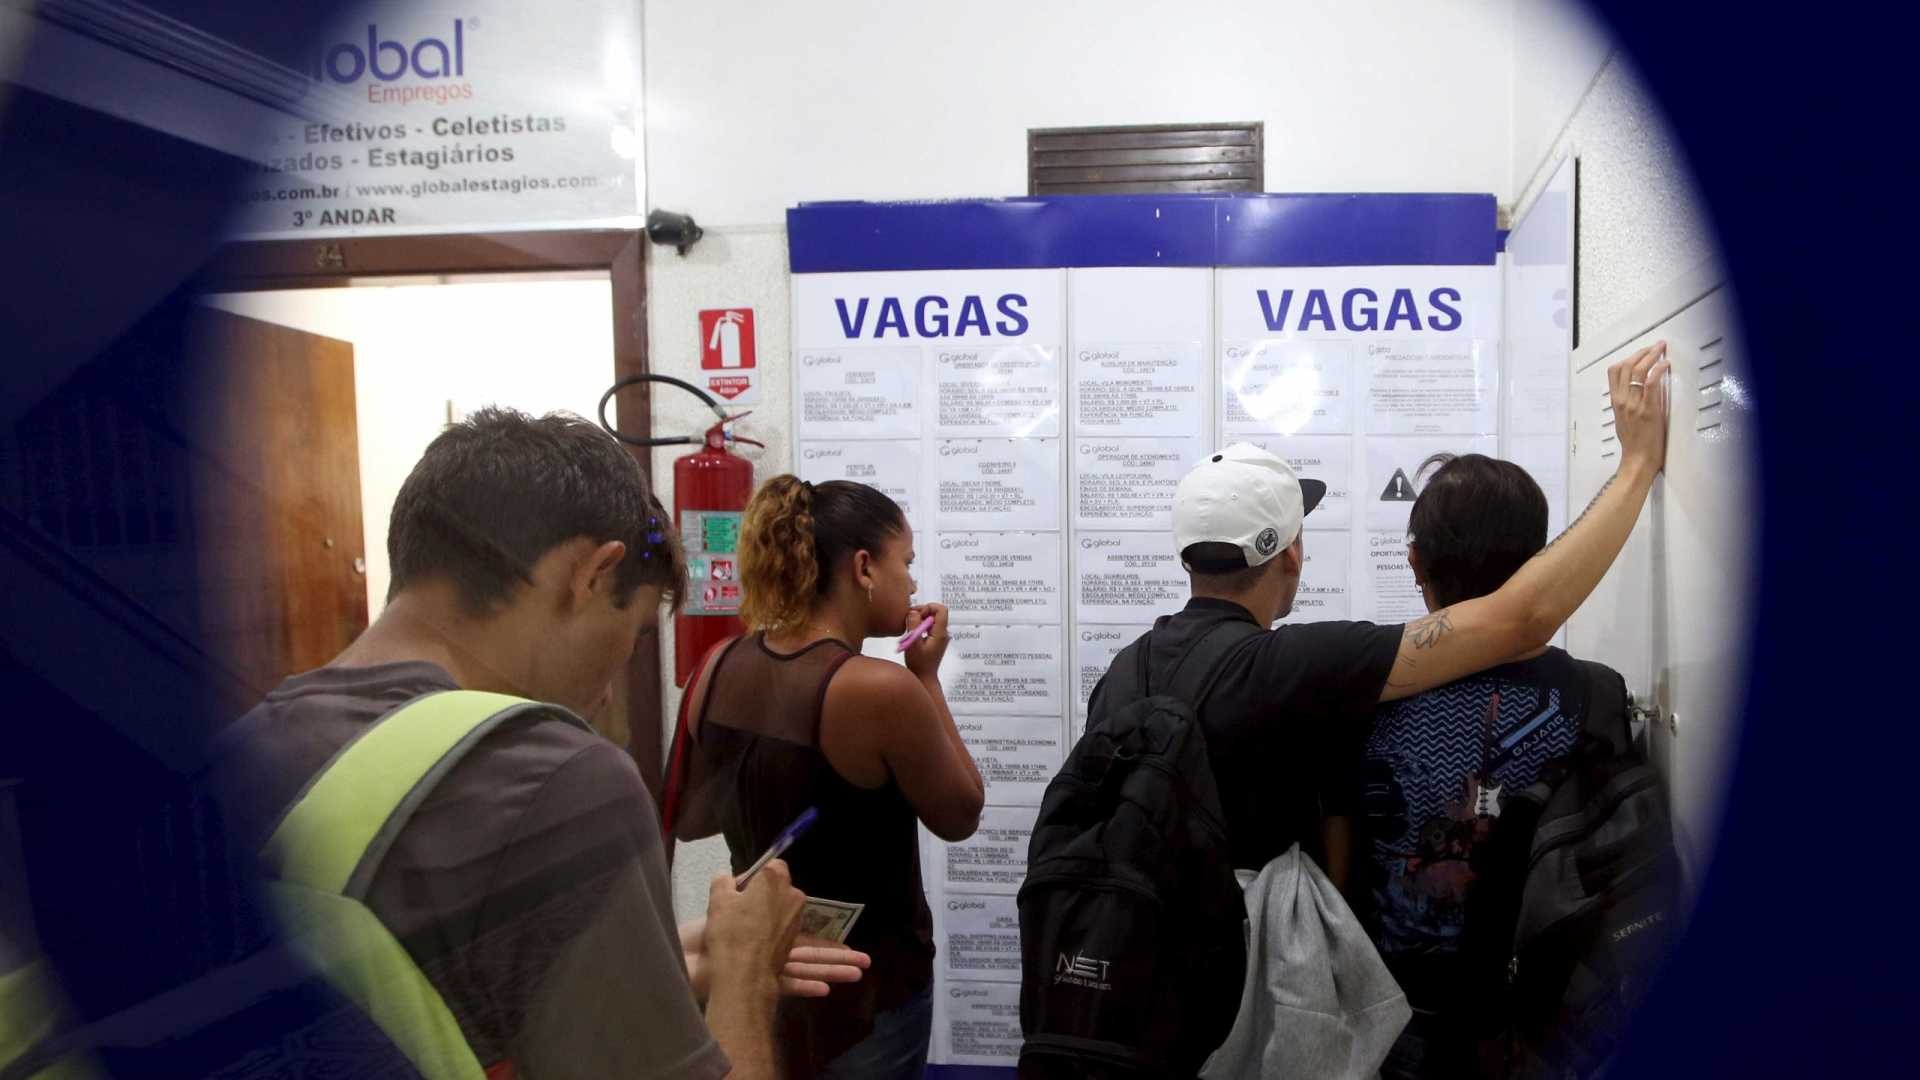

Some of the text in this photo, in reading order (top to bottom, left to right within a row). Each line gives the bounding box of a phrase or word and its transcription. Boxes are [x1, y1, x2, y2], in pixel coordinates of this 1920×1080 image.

[368, 83, 473, 105] Empregos
[304, 122, 407, 144] Efetivos
[432, 113, 566, 136] Celetistas
[368, 142, 515, 170] Estagiários
[320, 208, 396, 226] ANDAR
[834, 293, 1029, 339] VAGAS
[1256, 287, 1463, 332] VAGAS
[1093, 538, 1121, 548] global
[953, 632, 981, 641] global
[1093, 632, 1121, 641] global
[1056, 951, 1110, 981] NET
